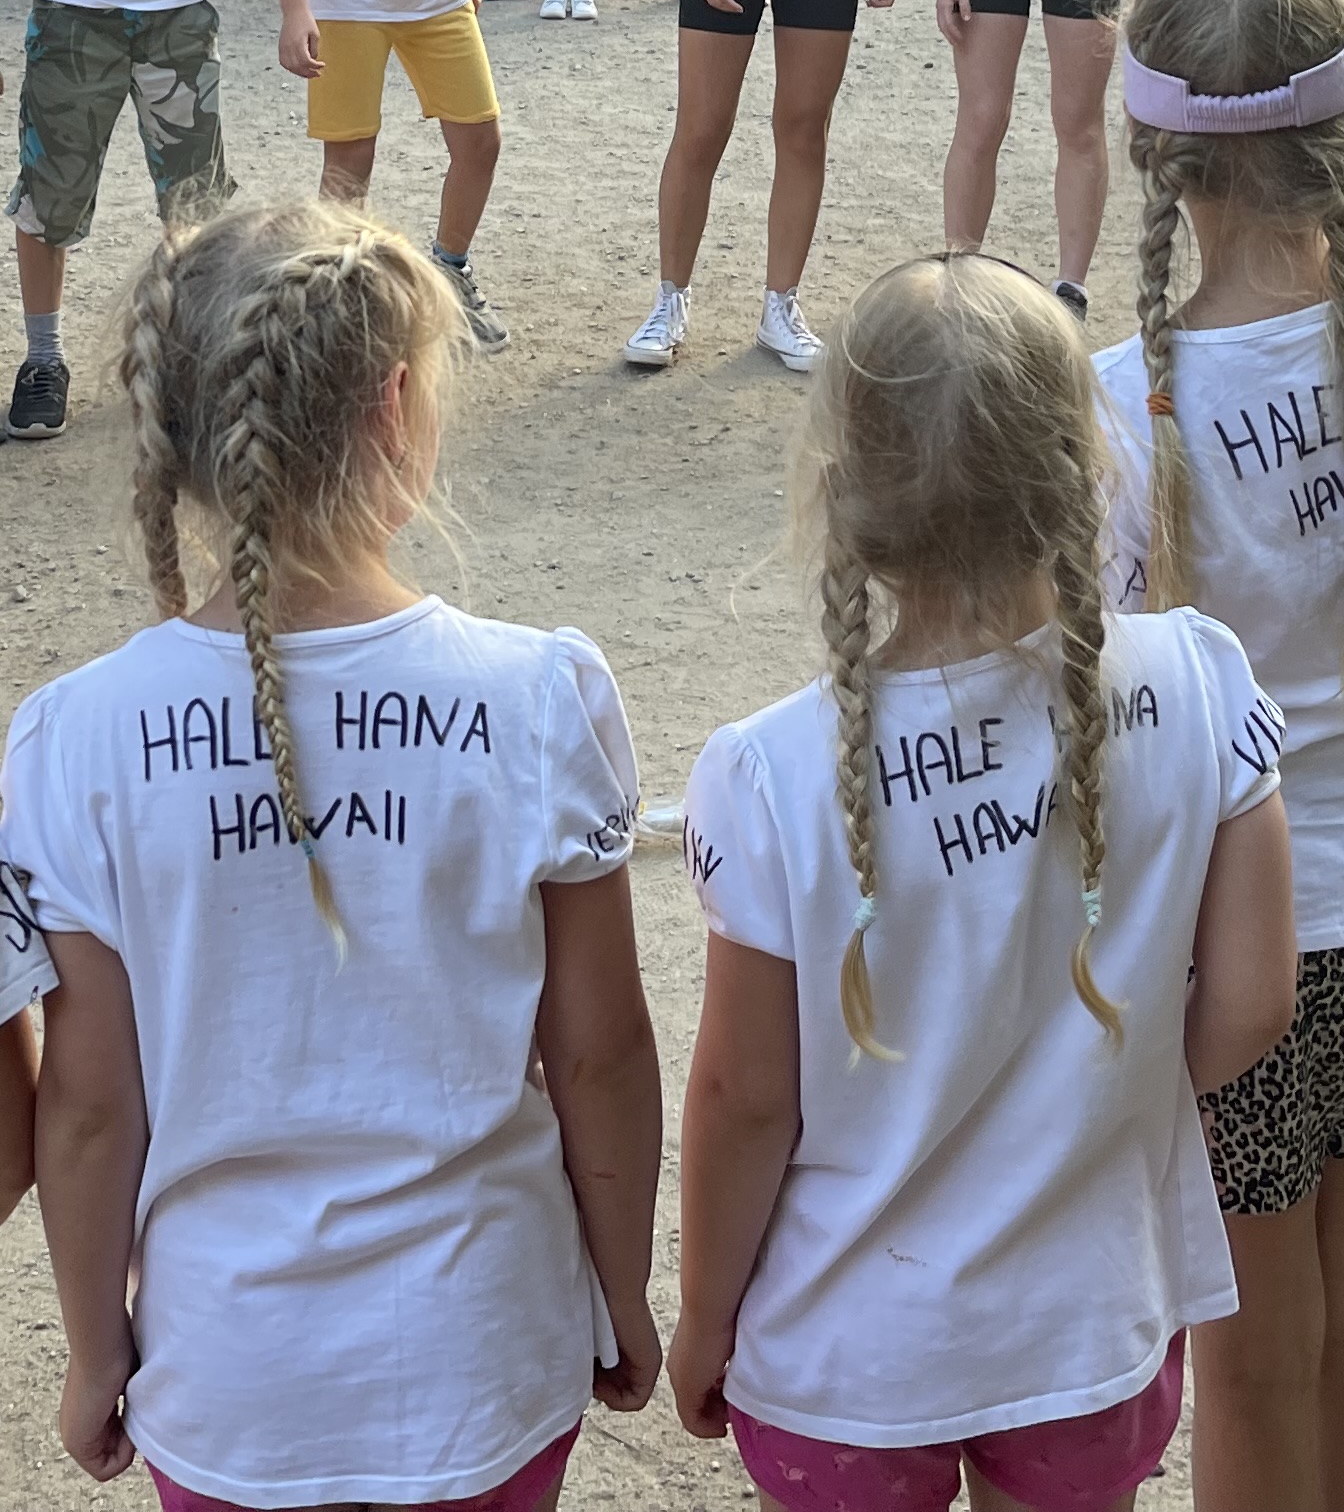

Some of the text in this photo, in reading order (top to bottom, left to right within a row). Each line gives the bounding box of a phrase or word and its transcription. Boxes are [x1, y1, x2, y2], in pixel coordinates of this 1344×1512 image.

[1213, 384, 1343, 481] HALE
[334, 690, 492, 754] HANA
[874, 717, 1005, 807] HALE
